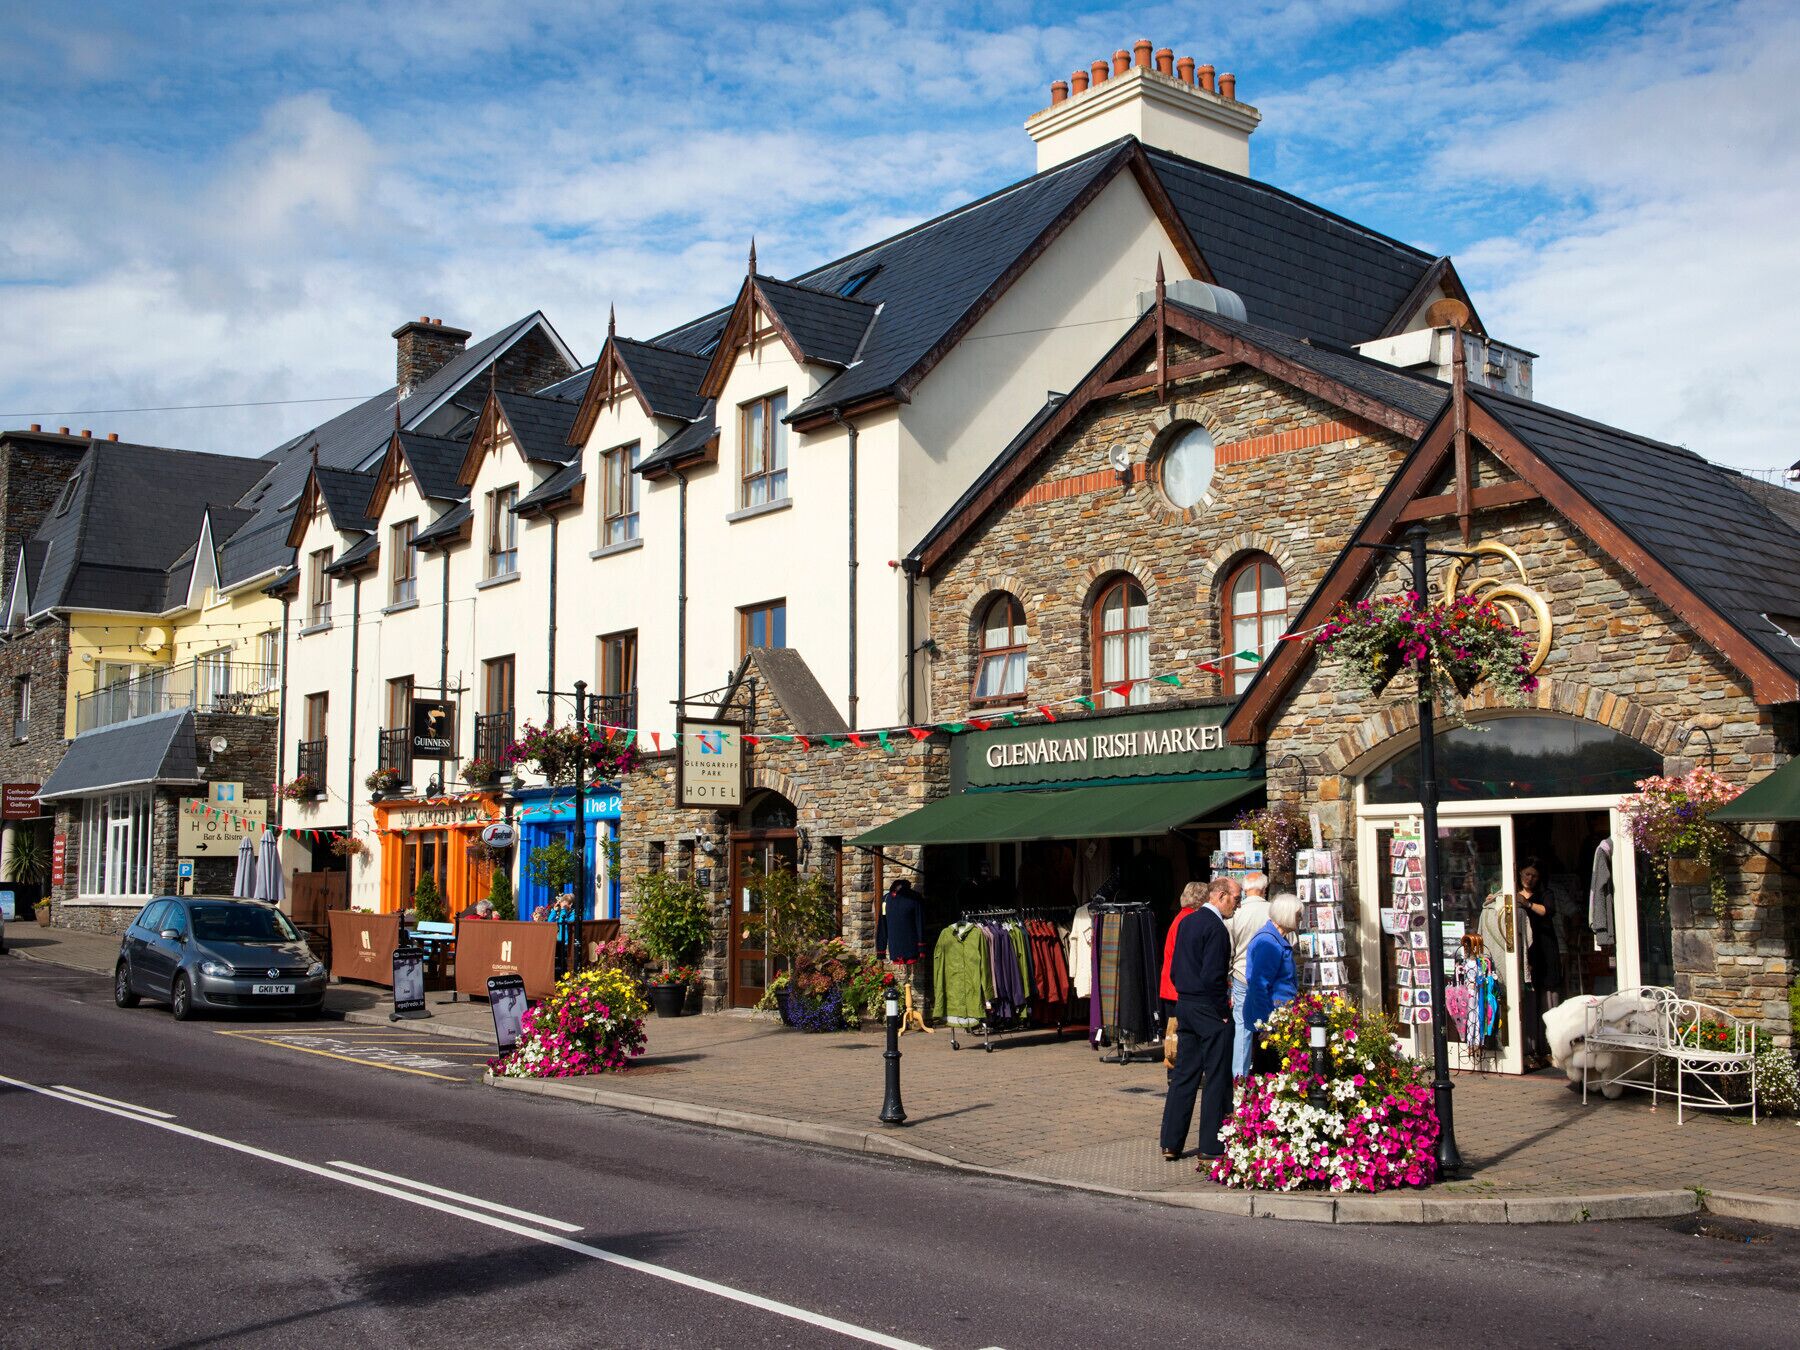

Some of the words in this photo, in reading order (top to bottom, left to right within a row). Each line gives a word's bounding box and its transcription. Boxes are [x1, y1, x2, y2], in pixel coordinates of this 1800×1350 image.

[414, 735, 451, 748] GUINNESS
[986, 738, 1088, 768] GLENARAN
[1093, 733, 1138, 759] IRISH
[1144, 725, 1224, 755] MARKET
[684, 760, 739, 768] GLENGARRIFF
[685, 786, 736, 798] HOTEL
[583, 797, 607, 813] The
[191, 821, 254, 832] HOTEL
[203, 833, 215, 841] Bar
[216, 833, 222, 841] &
[224, 833, 242, 841] Bistro
[182, 865, 190, 875] P
